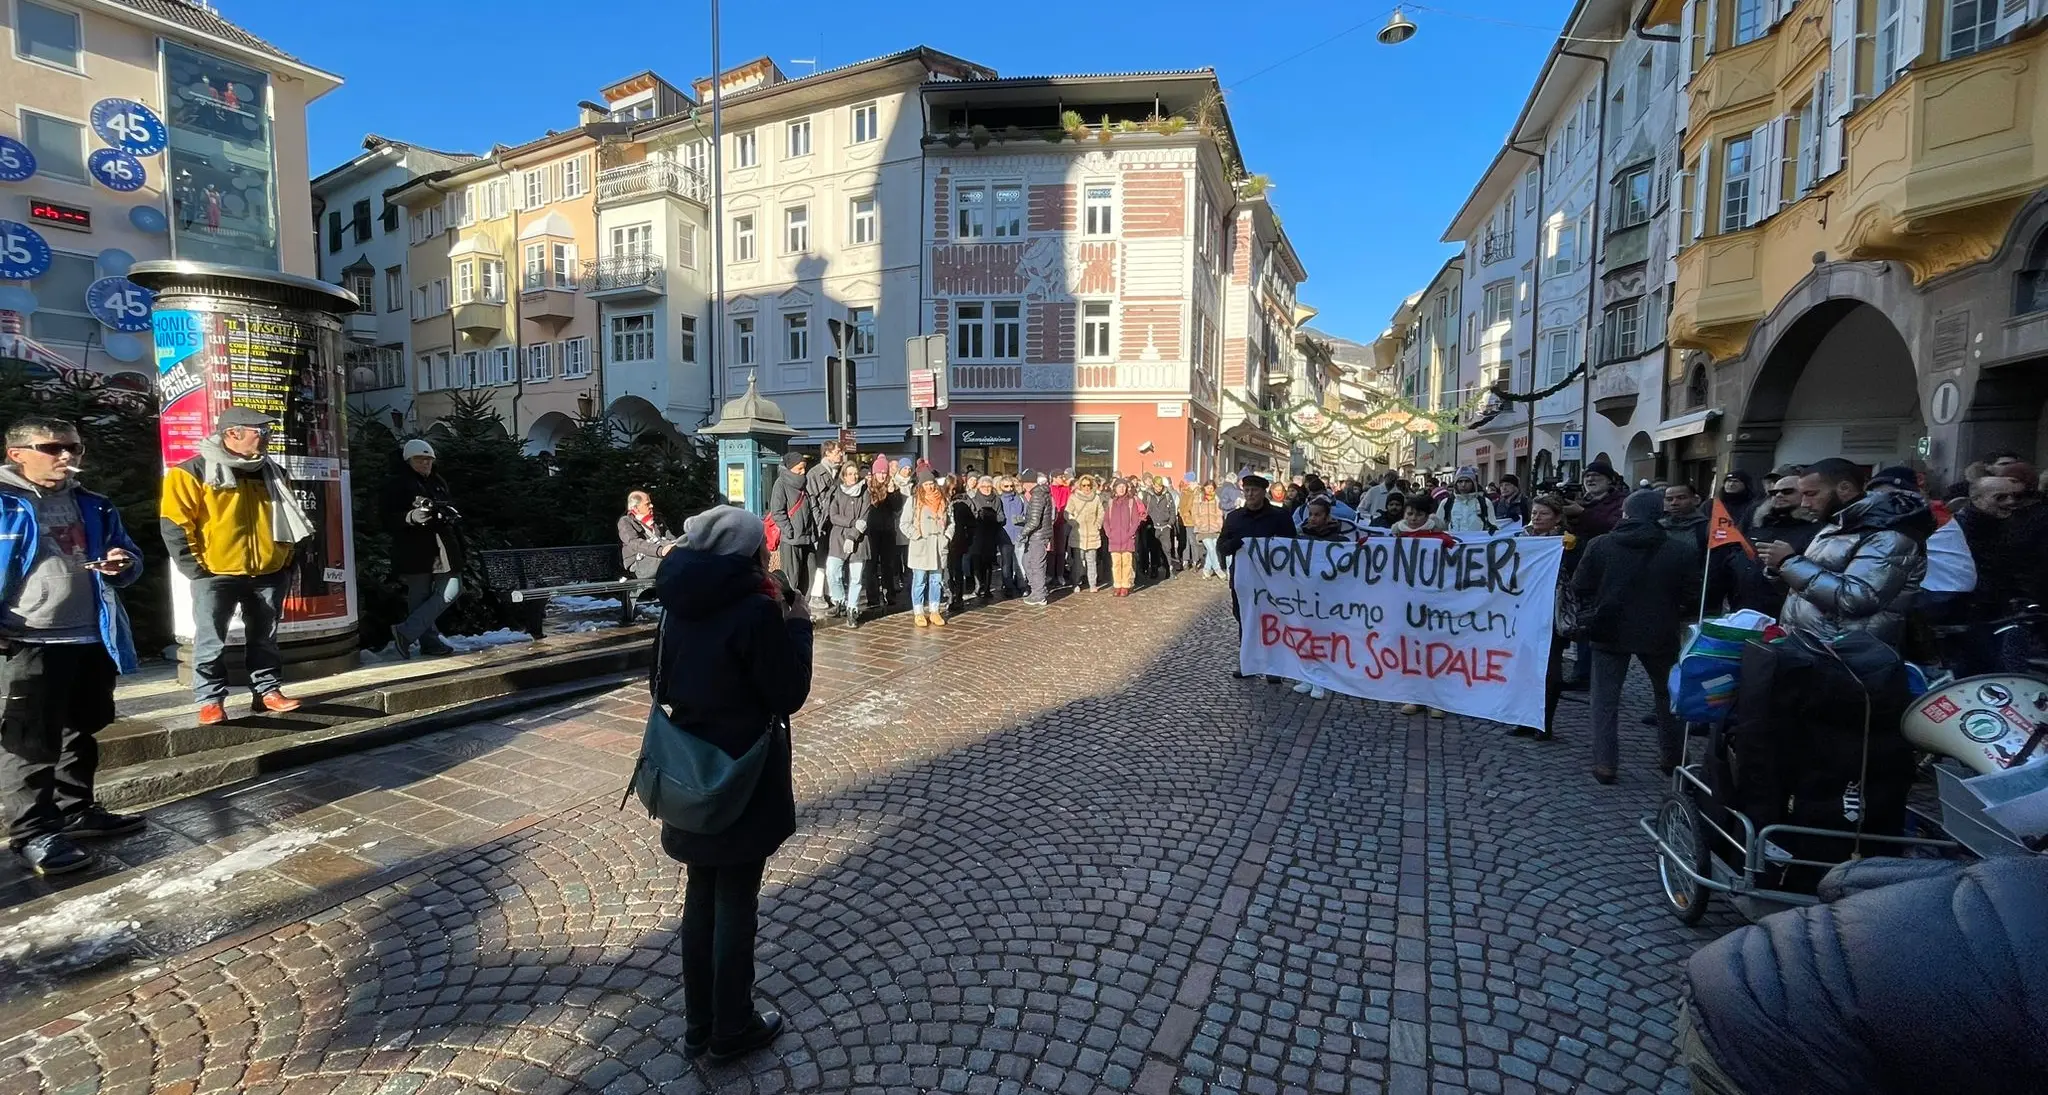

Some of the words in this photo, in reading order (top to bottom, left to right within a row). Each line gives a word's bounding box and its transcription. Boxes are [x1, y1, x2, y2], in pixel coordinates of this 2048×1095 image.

[106, 112, 152, 143] 45
[118, 143, 158, 156] YEARS
[101, 159, 134, 181] 45
[103, 290, 148, 319] 45
[160, 361, 187, 391] David
[165, 373, 202, 400] Childs
[962, 430, 1012, 443] Camicissima
[1249, 537, 1314, 578] NON
[1253, 586, 1385, 630] restiamo
